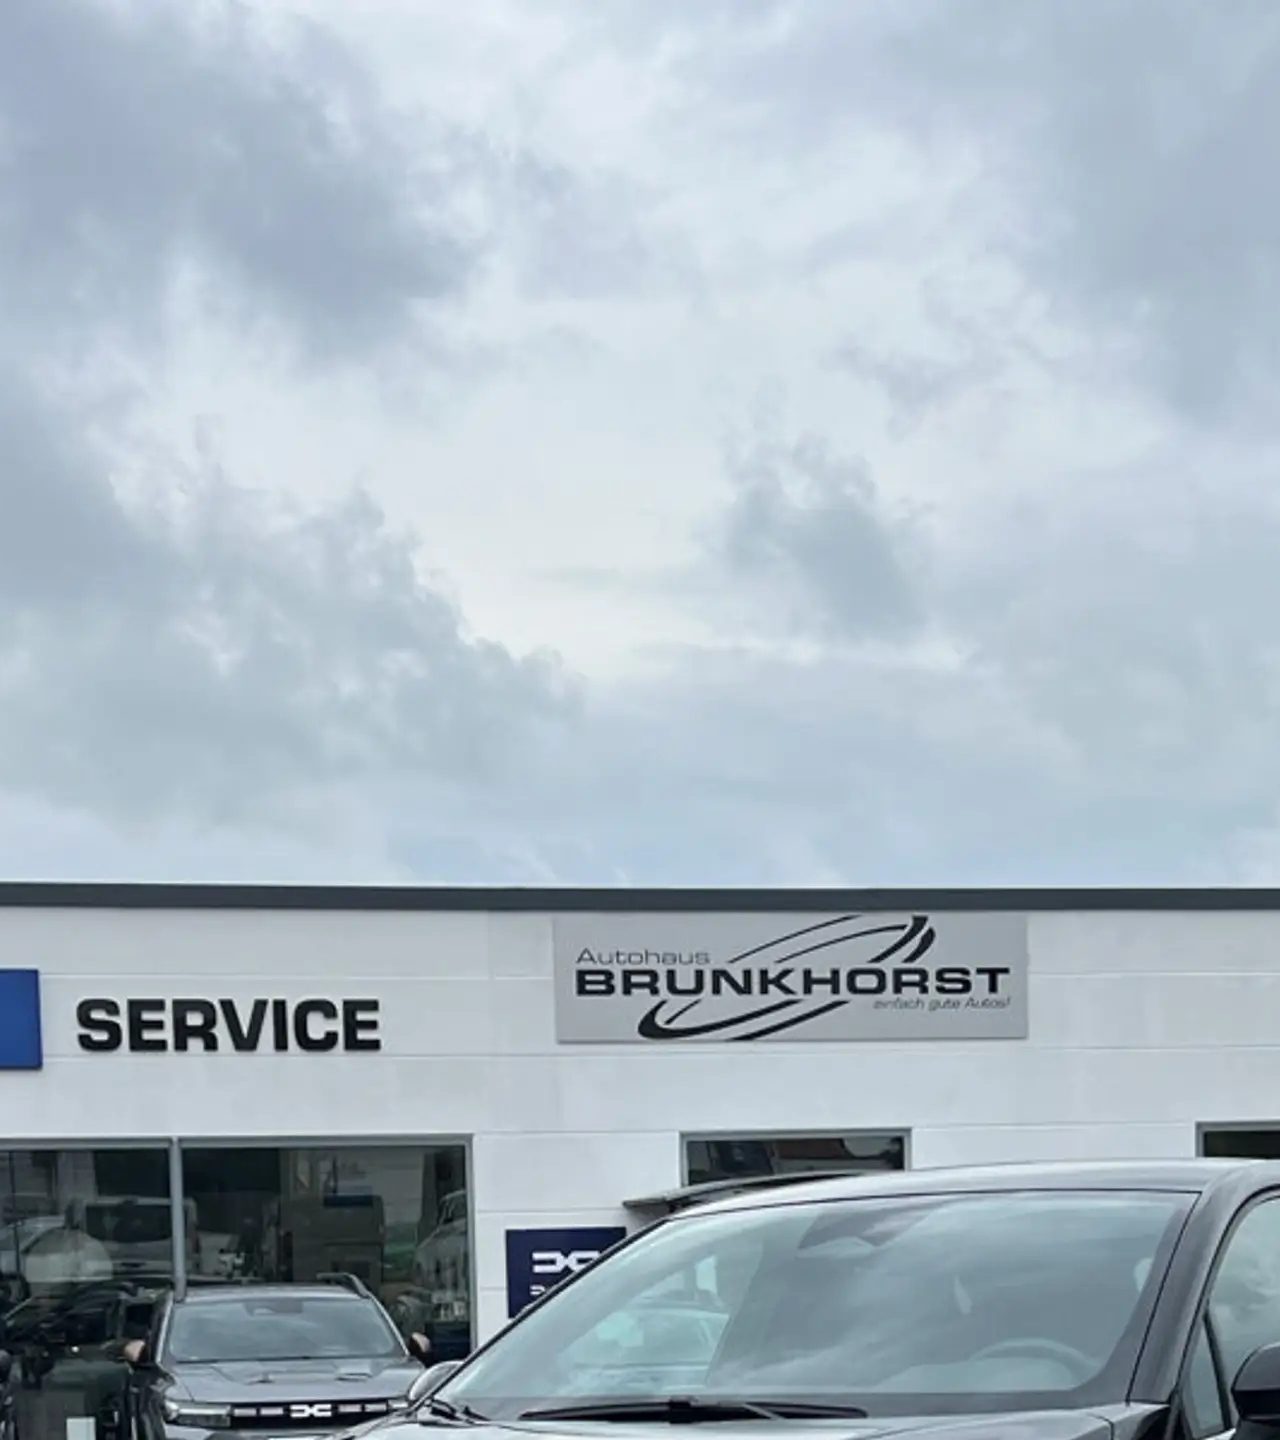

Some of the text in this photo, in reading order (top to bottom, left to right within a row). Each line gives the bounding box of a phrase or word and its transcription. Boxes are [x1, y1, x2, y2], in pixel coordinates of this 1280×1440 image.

[575, 947, 710, 964] Autohaus
[576, 967, 1010, 996] BRUNKHORST
[76, 998, 381, 1052] SERVICE
